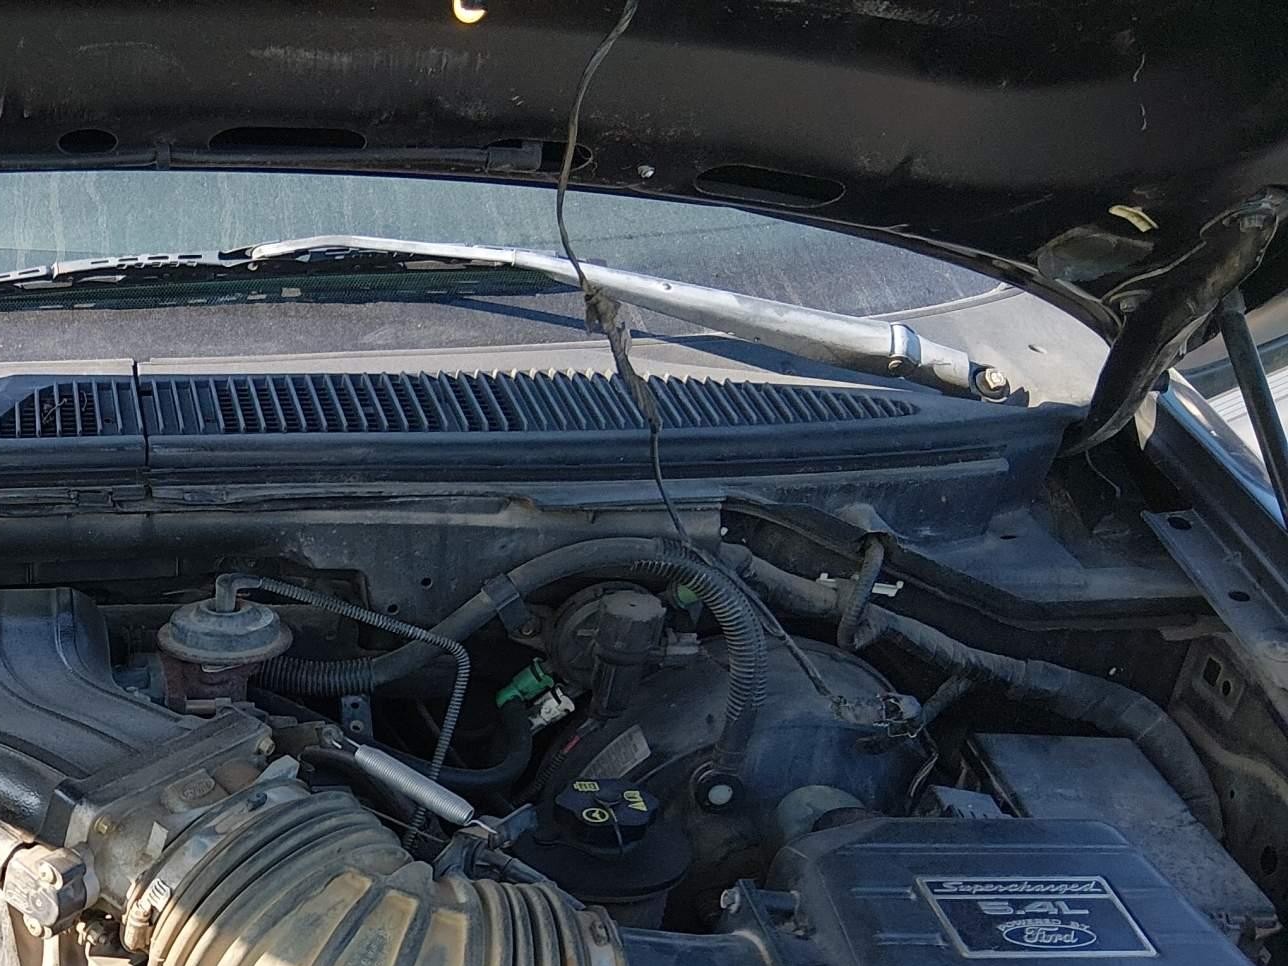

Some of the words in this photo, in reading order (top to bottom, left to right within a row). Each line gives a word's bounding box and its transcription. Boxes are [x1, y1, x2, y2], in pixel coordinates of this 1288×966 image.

[934, 881, 1101, 894] Supercharged
[978, 900, 1089, 914] 5.4L
[998, 918, 1061, 931] POWERED
[1023, 927, 1078, 943] Ford
